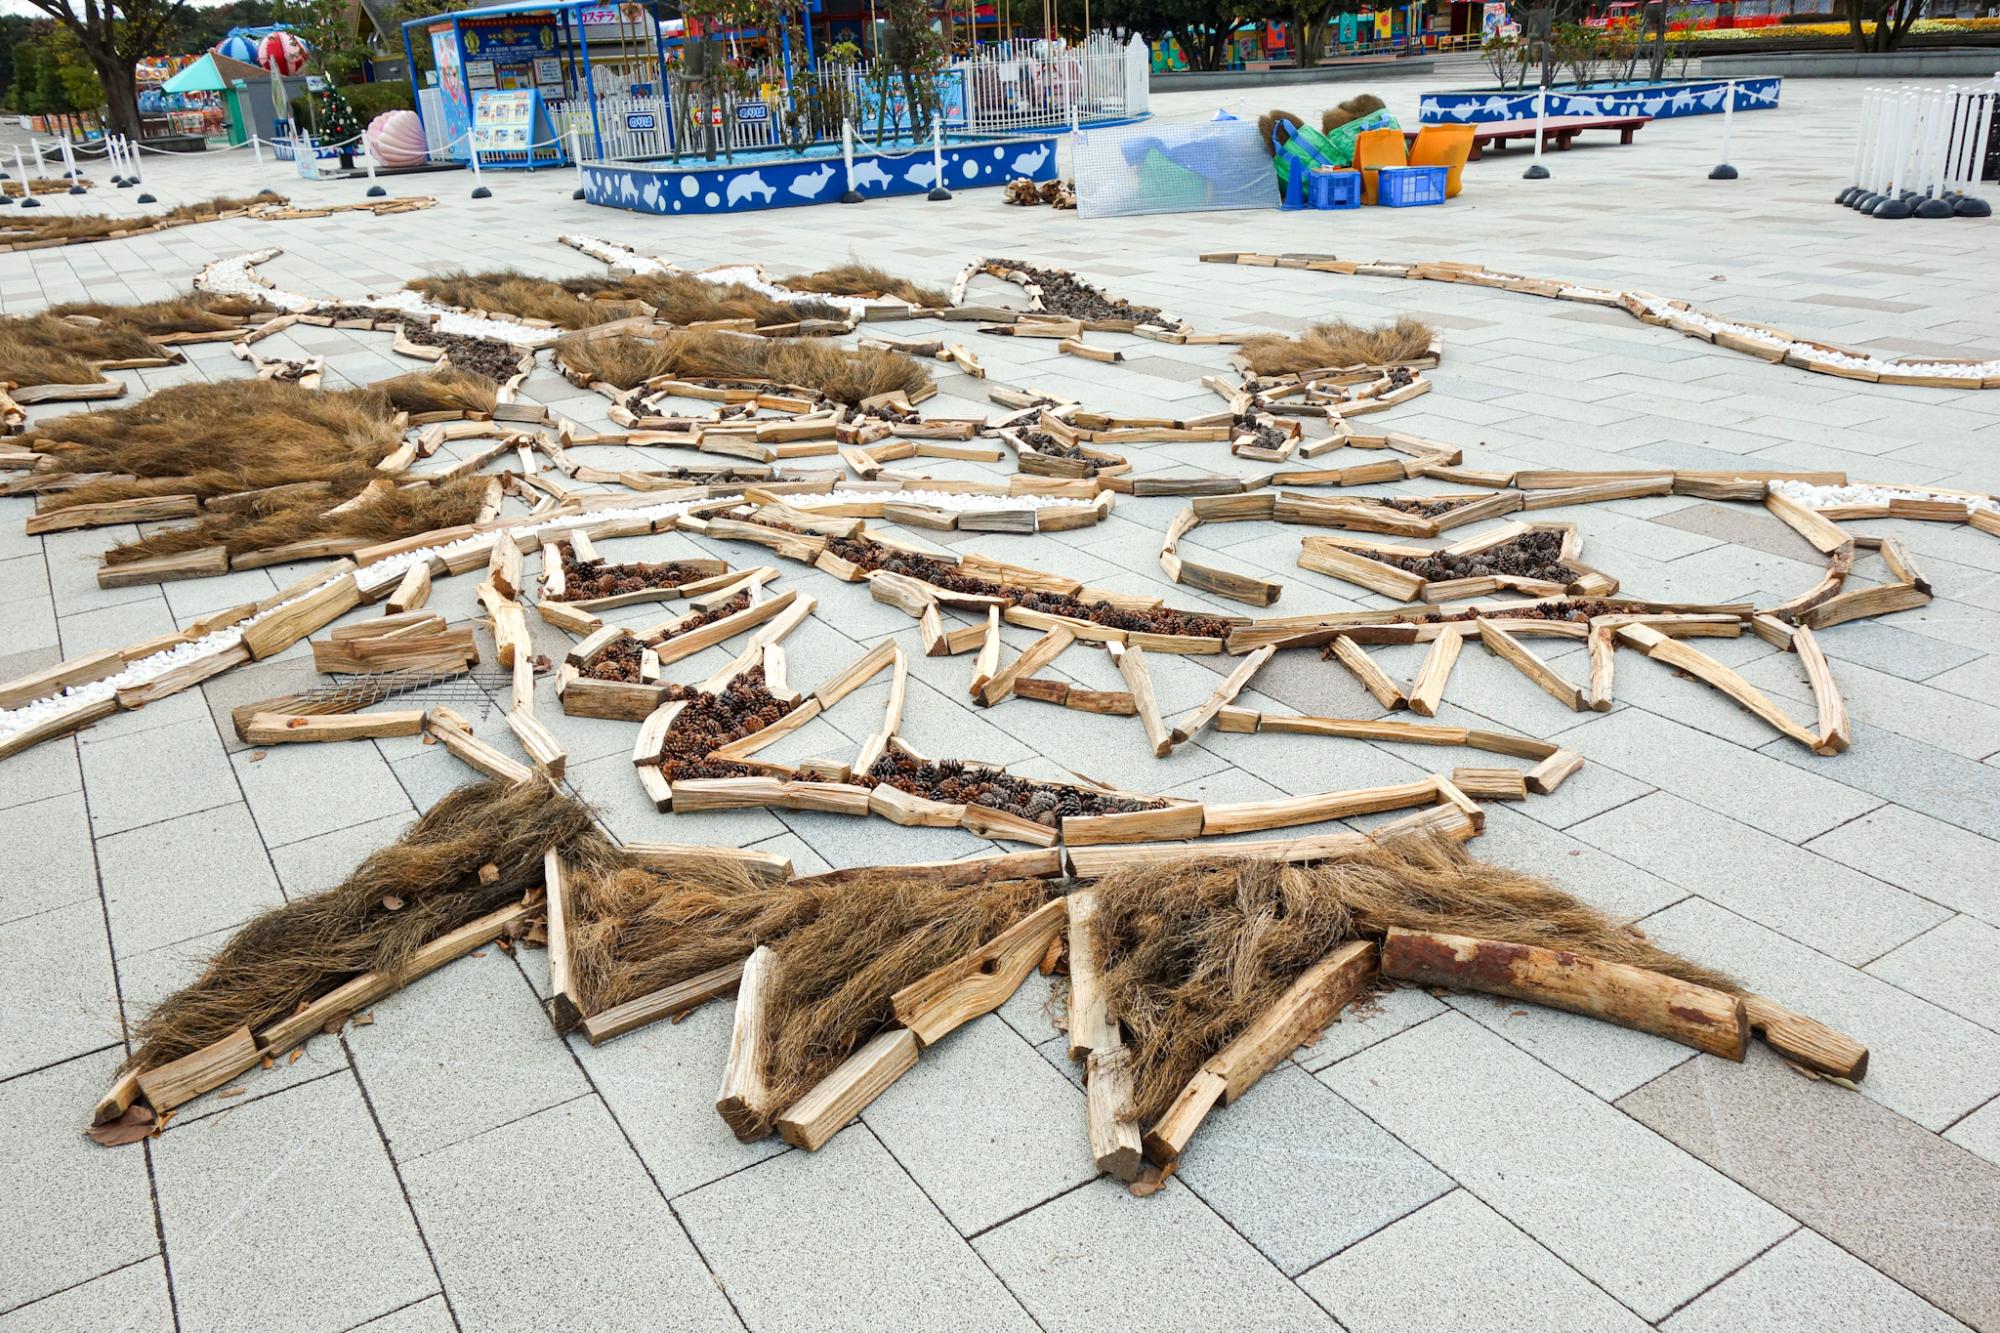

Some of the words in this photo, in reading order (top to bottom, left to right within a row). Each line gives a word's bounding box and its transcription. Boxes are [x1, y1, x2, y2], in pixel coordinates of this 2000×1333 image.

[740, 107, 765, 118] のりば
[630, 117, 653, 127] のりば
